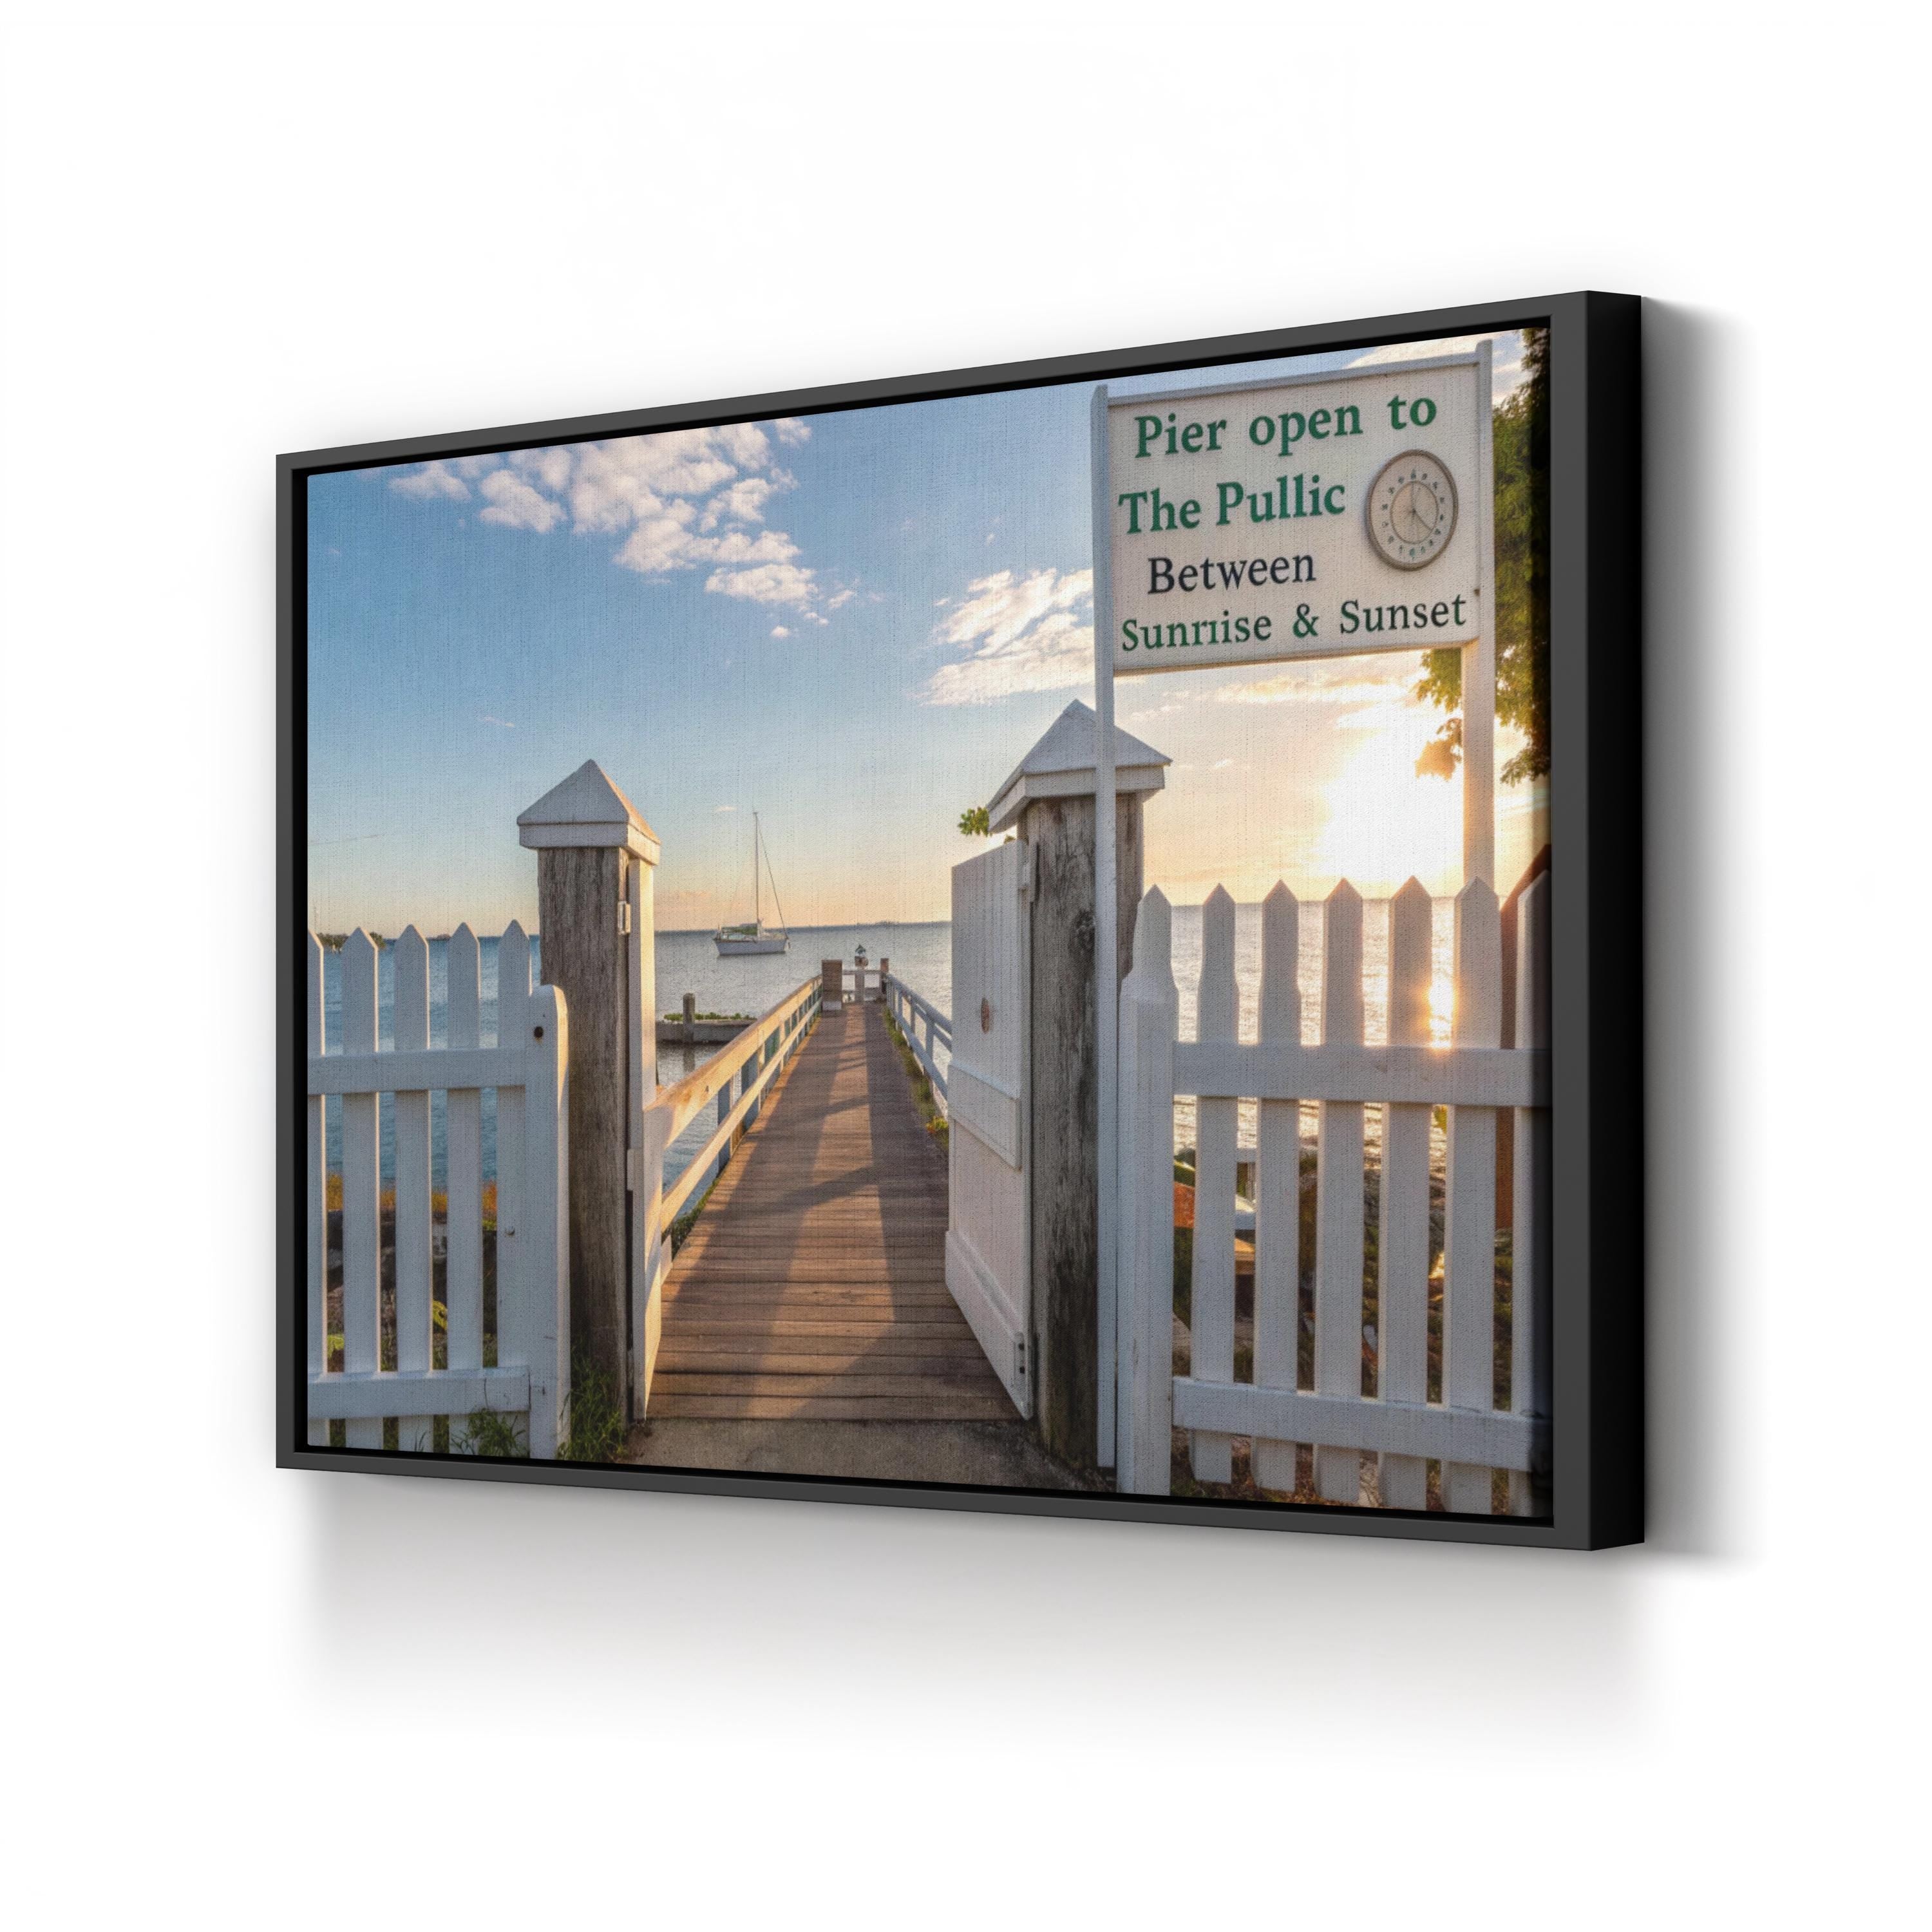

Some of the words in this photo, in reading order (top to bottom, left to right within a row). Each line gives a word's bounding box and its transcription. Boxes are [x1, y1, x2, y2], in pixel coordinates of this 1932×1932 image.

[1135, 412, 1227, 458] Pier
[1249, 401, 1363, 457] open
[1387, 394, 1437, 430] to
[1118, 488, 1201, 534] The
[1216, 473, 1345, 526] Pullic
[1148, 553, 1316, 594] Between
[1293, 603, 1319, 638] &
[1340, 594, 1466, 634] Sunset
